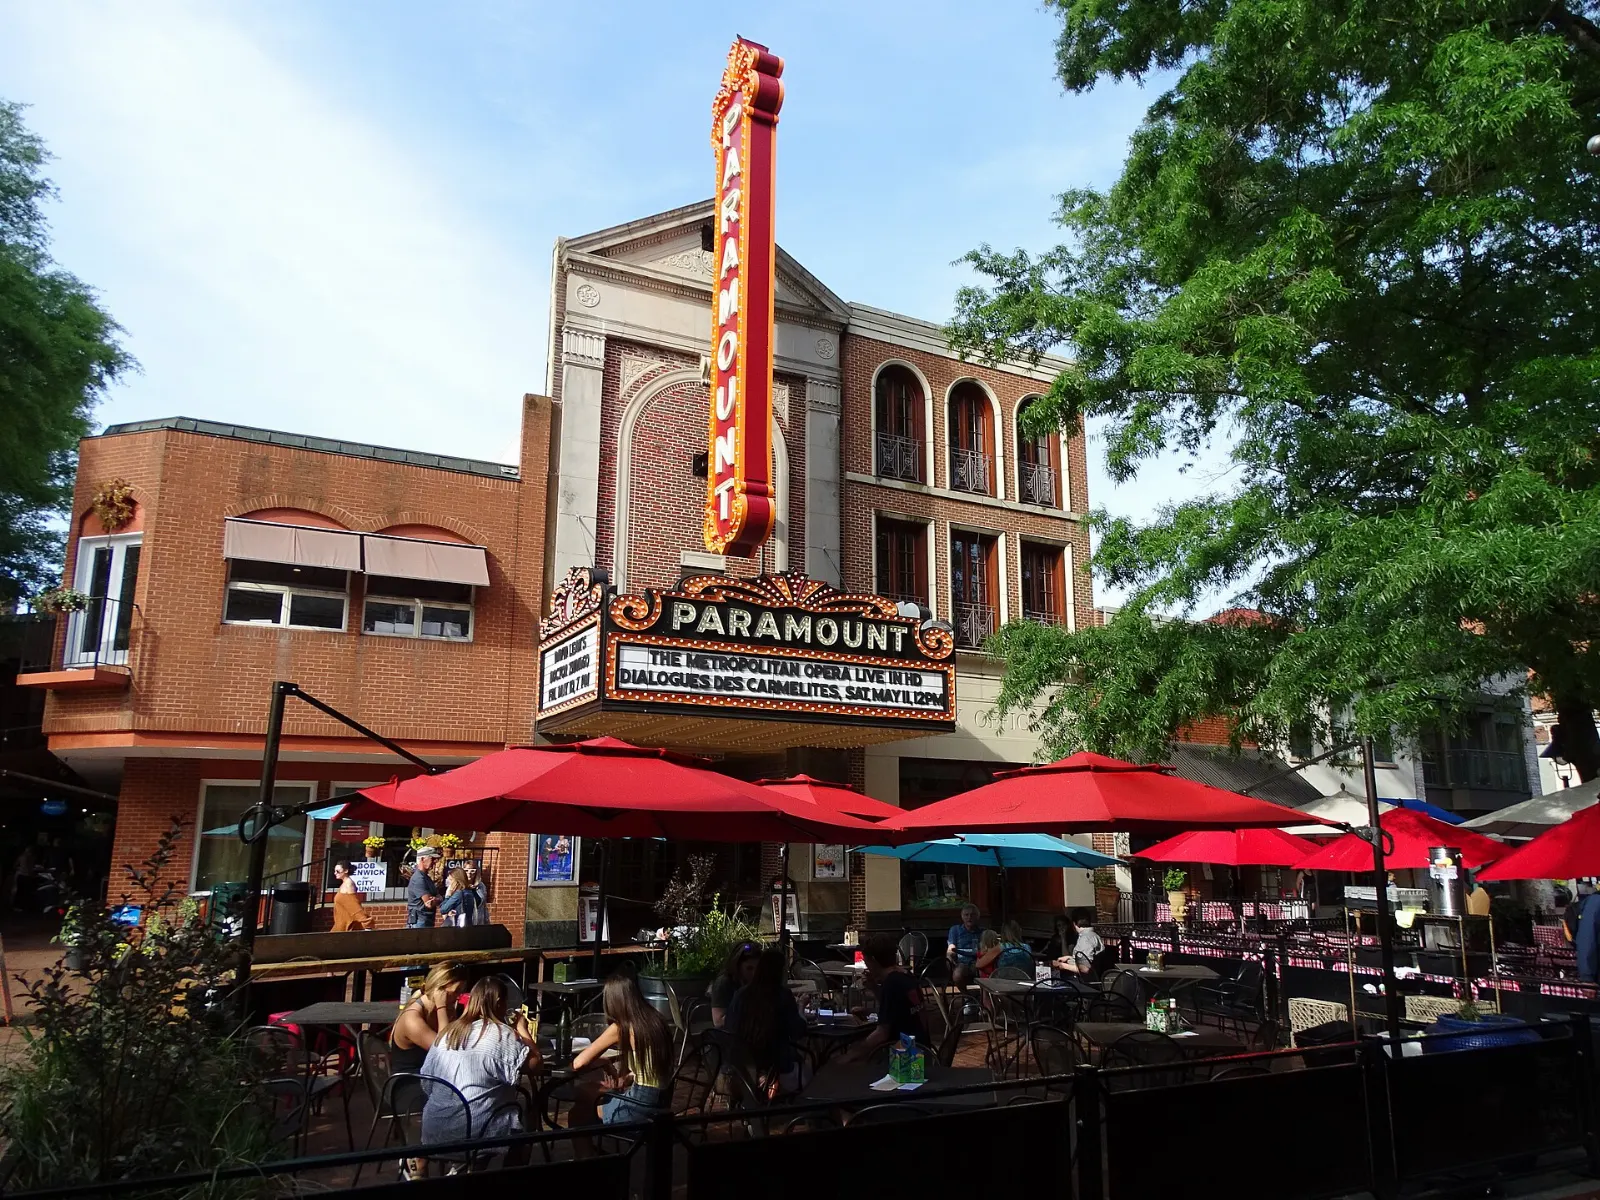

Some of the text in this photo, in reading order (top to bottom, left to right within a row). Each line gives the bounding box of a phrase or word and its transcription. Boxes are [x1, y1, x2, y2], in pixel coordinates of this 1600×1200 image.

[714, 102, 742, 522] PARAMOUNT
[672, 601, 909, 652] PARAMOUNT
[620, 668, 711, 689] DIALOGUES
[714, 675, 744, 692] DES
[747, 677, 842, 702] CARMELITES,
[872, 688, 901, 704] MAY
[650, 650, 923, 687] THE METROPOLITAN OPERA LIVE IN HD
[357, 862, 376, 870] BOB
